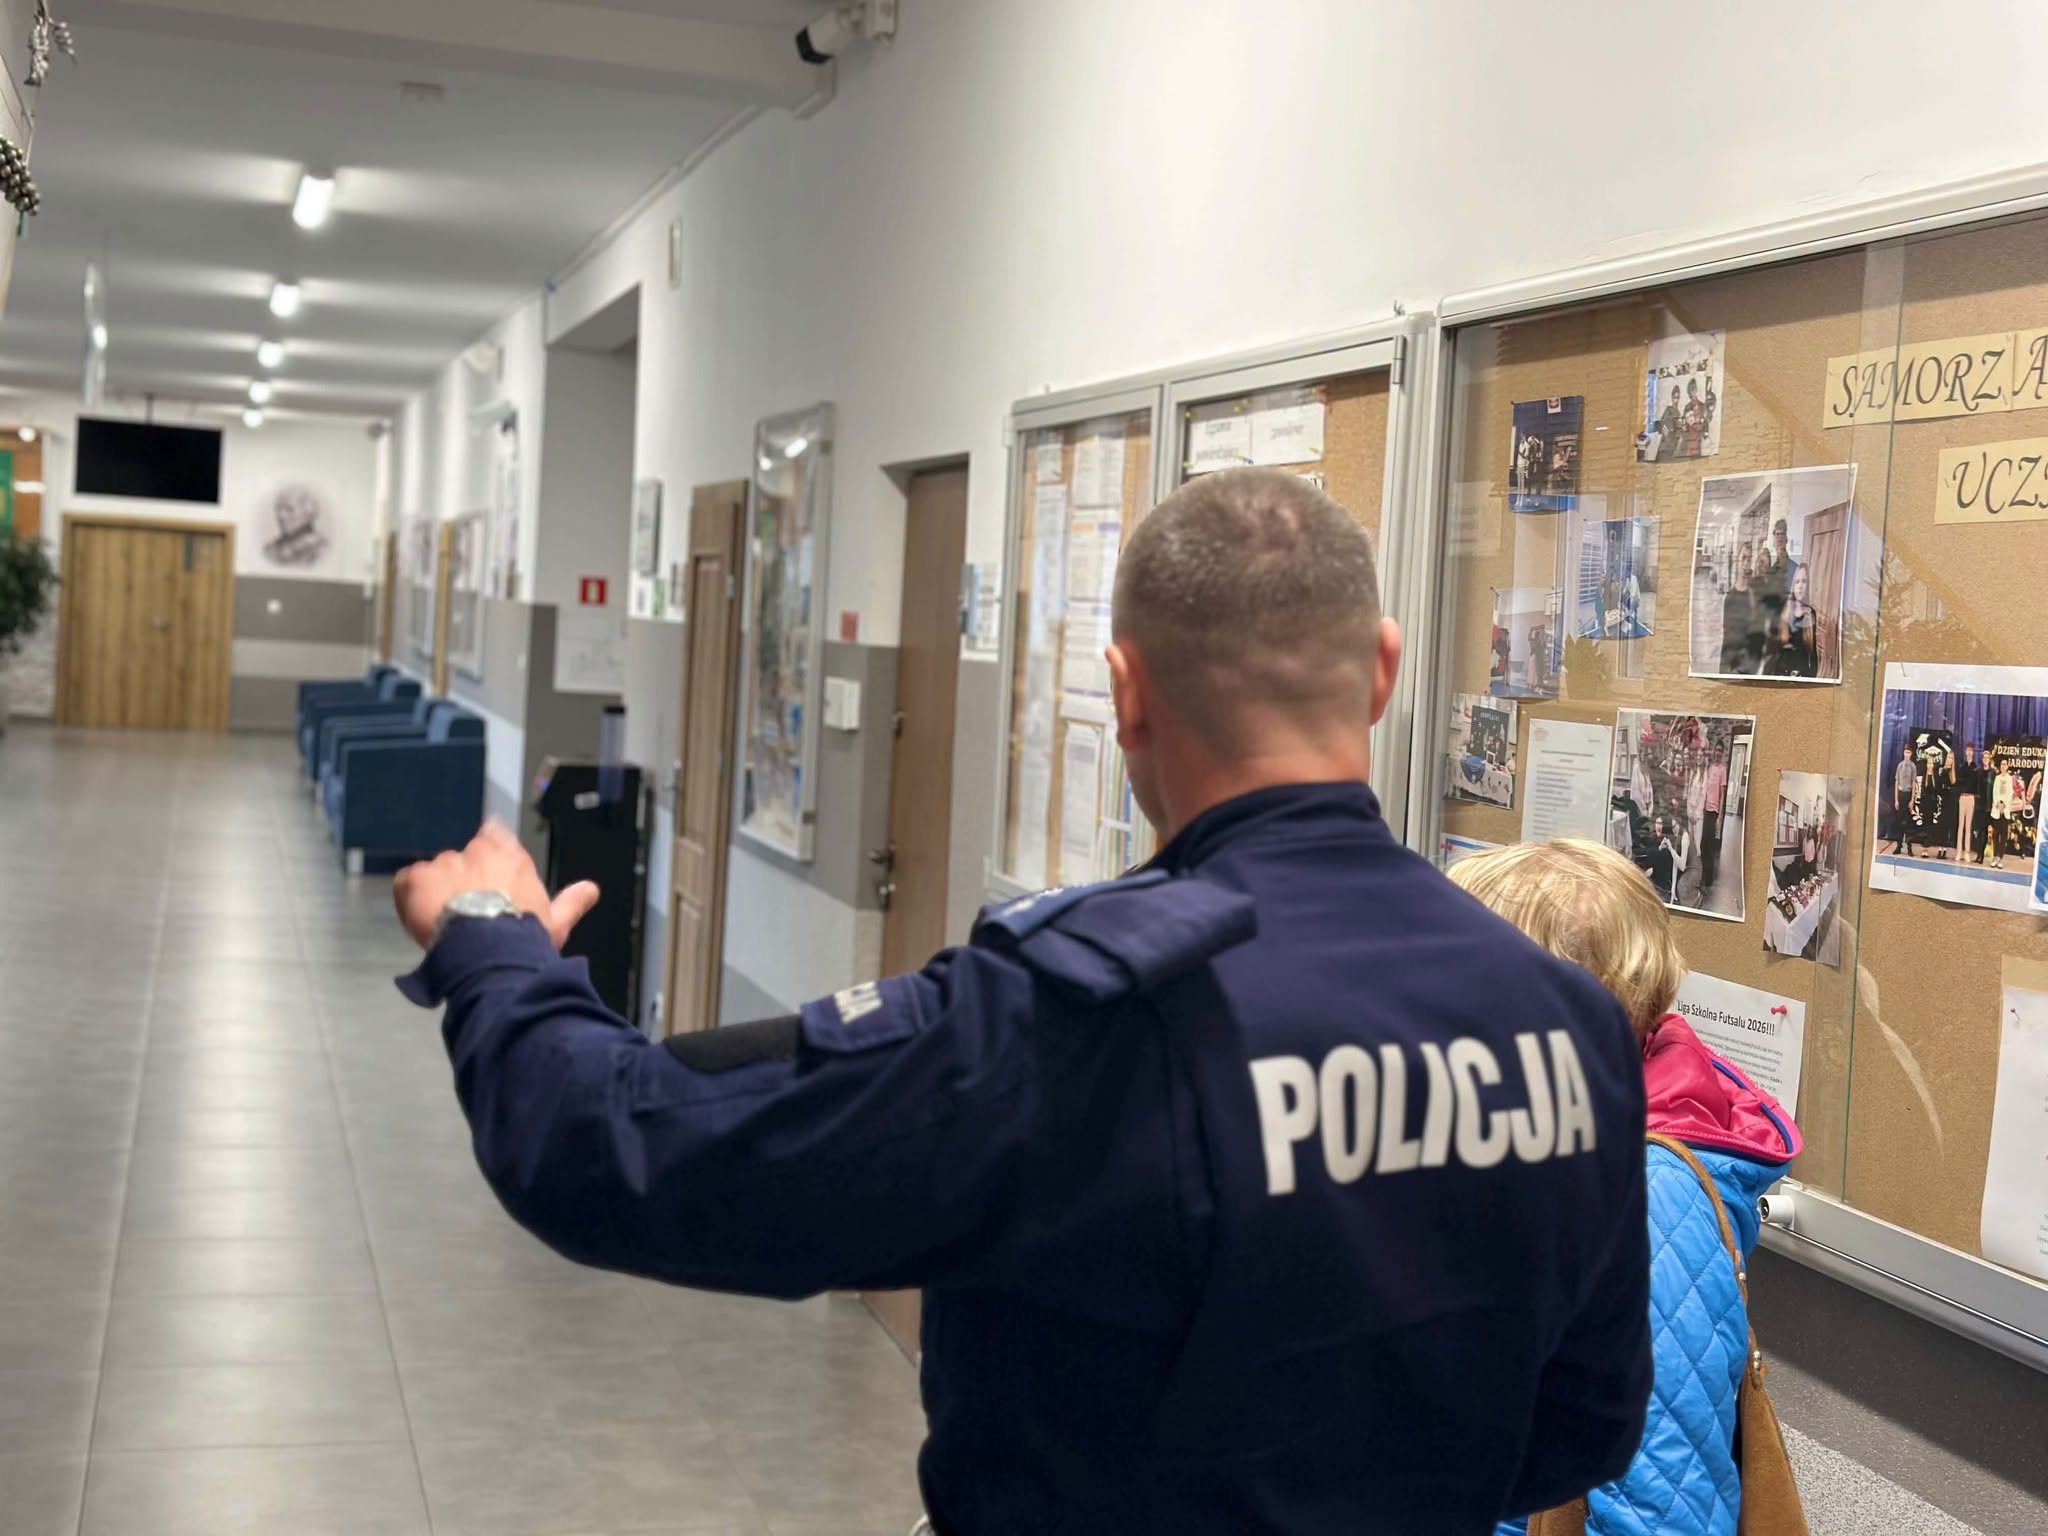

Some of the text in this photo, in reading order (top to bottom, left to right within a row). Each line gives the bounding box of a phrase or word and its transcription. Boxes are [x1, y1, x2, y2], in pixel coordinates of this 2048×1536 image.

[1677, 1000, 1775, 1036] Liga Szkolna Futsalu 2026!!!
[1249, 1029, 1597, 1197] POLICJA
